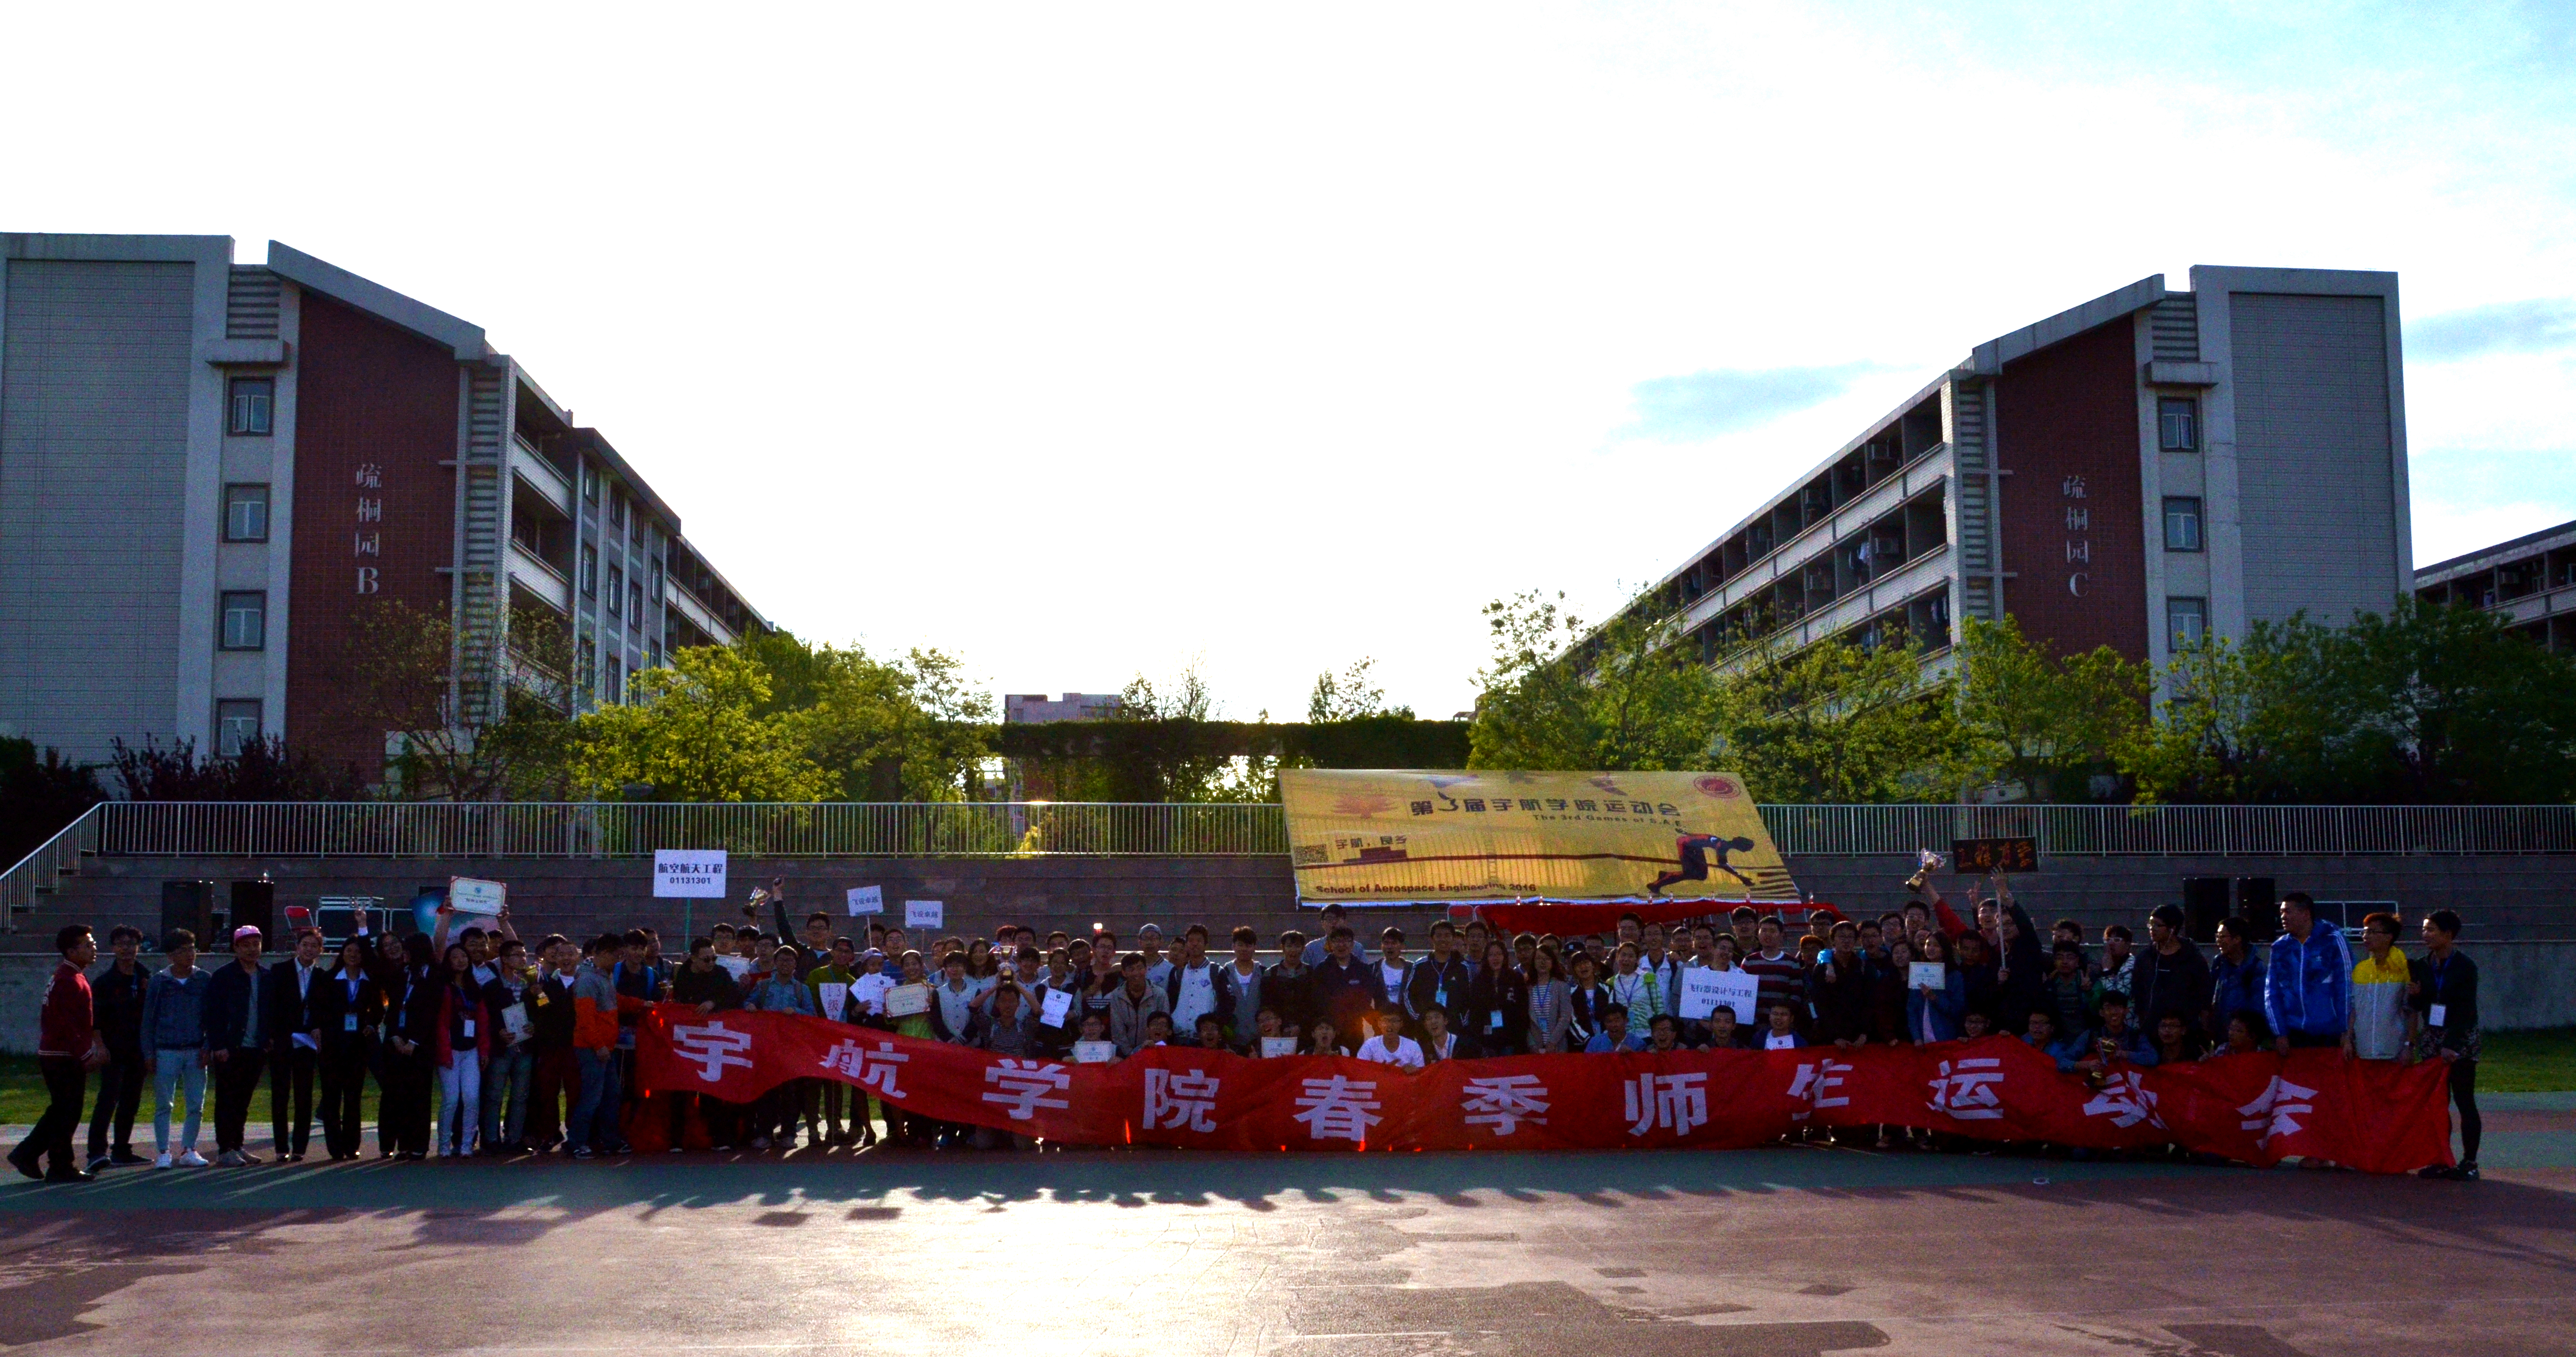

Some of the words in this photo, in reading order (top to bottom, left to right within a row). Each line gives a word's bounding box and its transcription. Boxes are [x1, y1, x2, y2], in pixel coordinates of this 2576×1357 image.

[355, 463, 382, 594] 疏桐园B
[659, 863, 723, 873] 航空航天工程
[1316, 884, 1355, 894] School
[1359, 883, 1370, 893] of
[1374, 883, 1435, 893] Aerospace
[1438, 882, 1505, 892] Engineering
[1509, 883, 1536, 892] 2016
[1690, 984, 1752, 997] 飞行器设计与工程
[672, 1020, 2319, 1151] 宇航学院春季师生运动会
